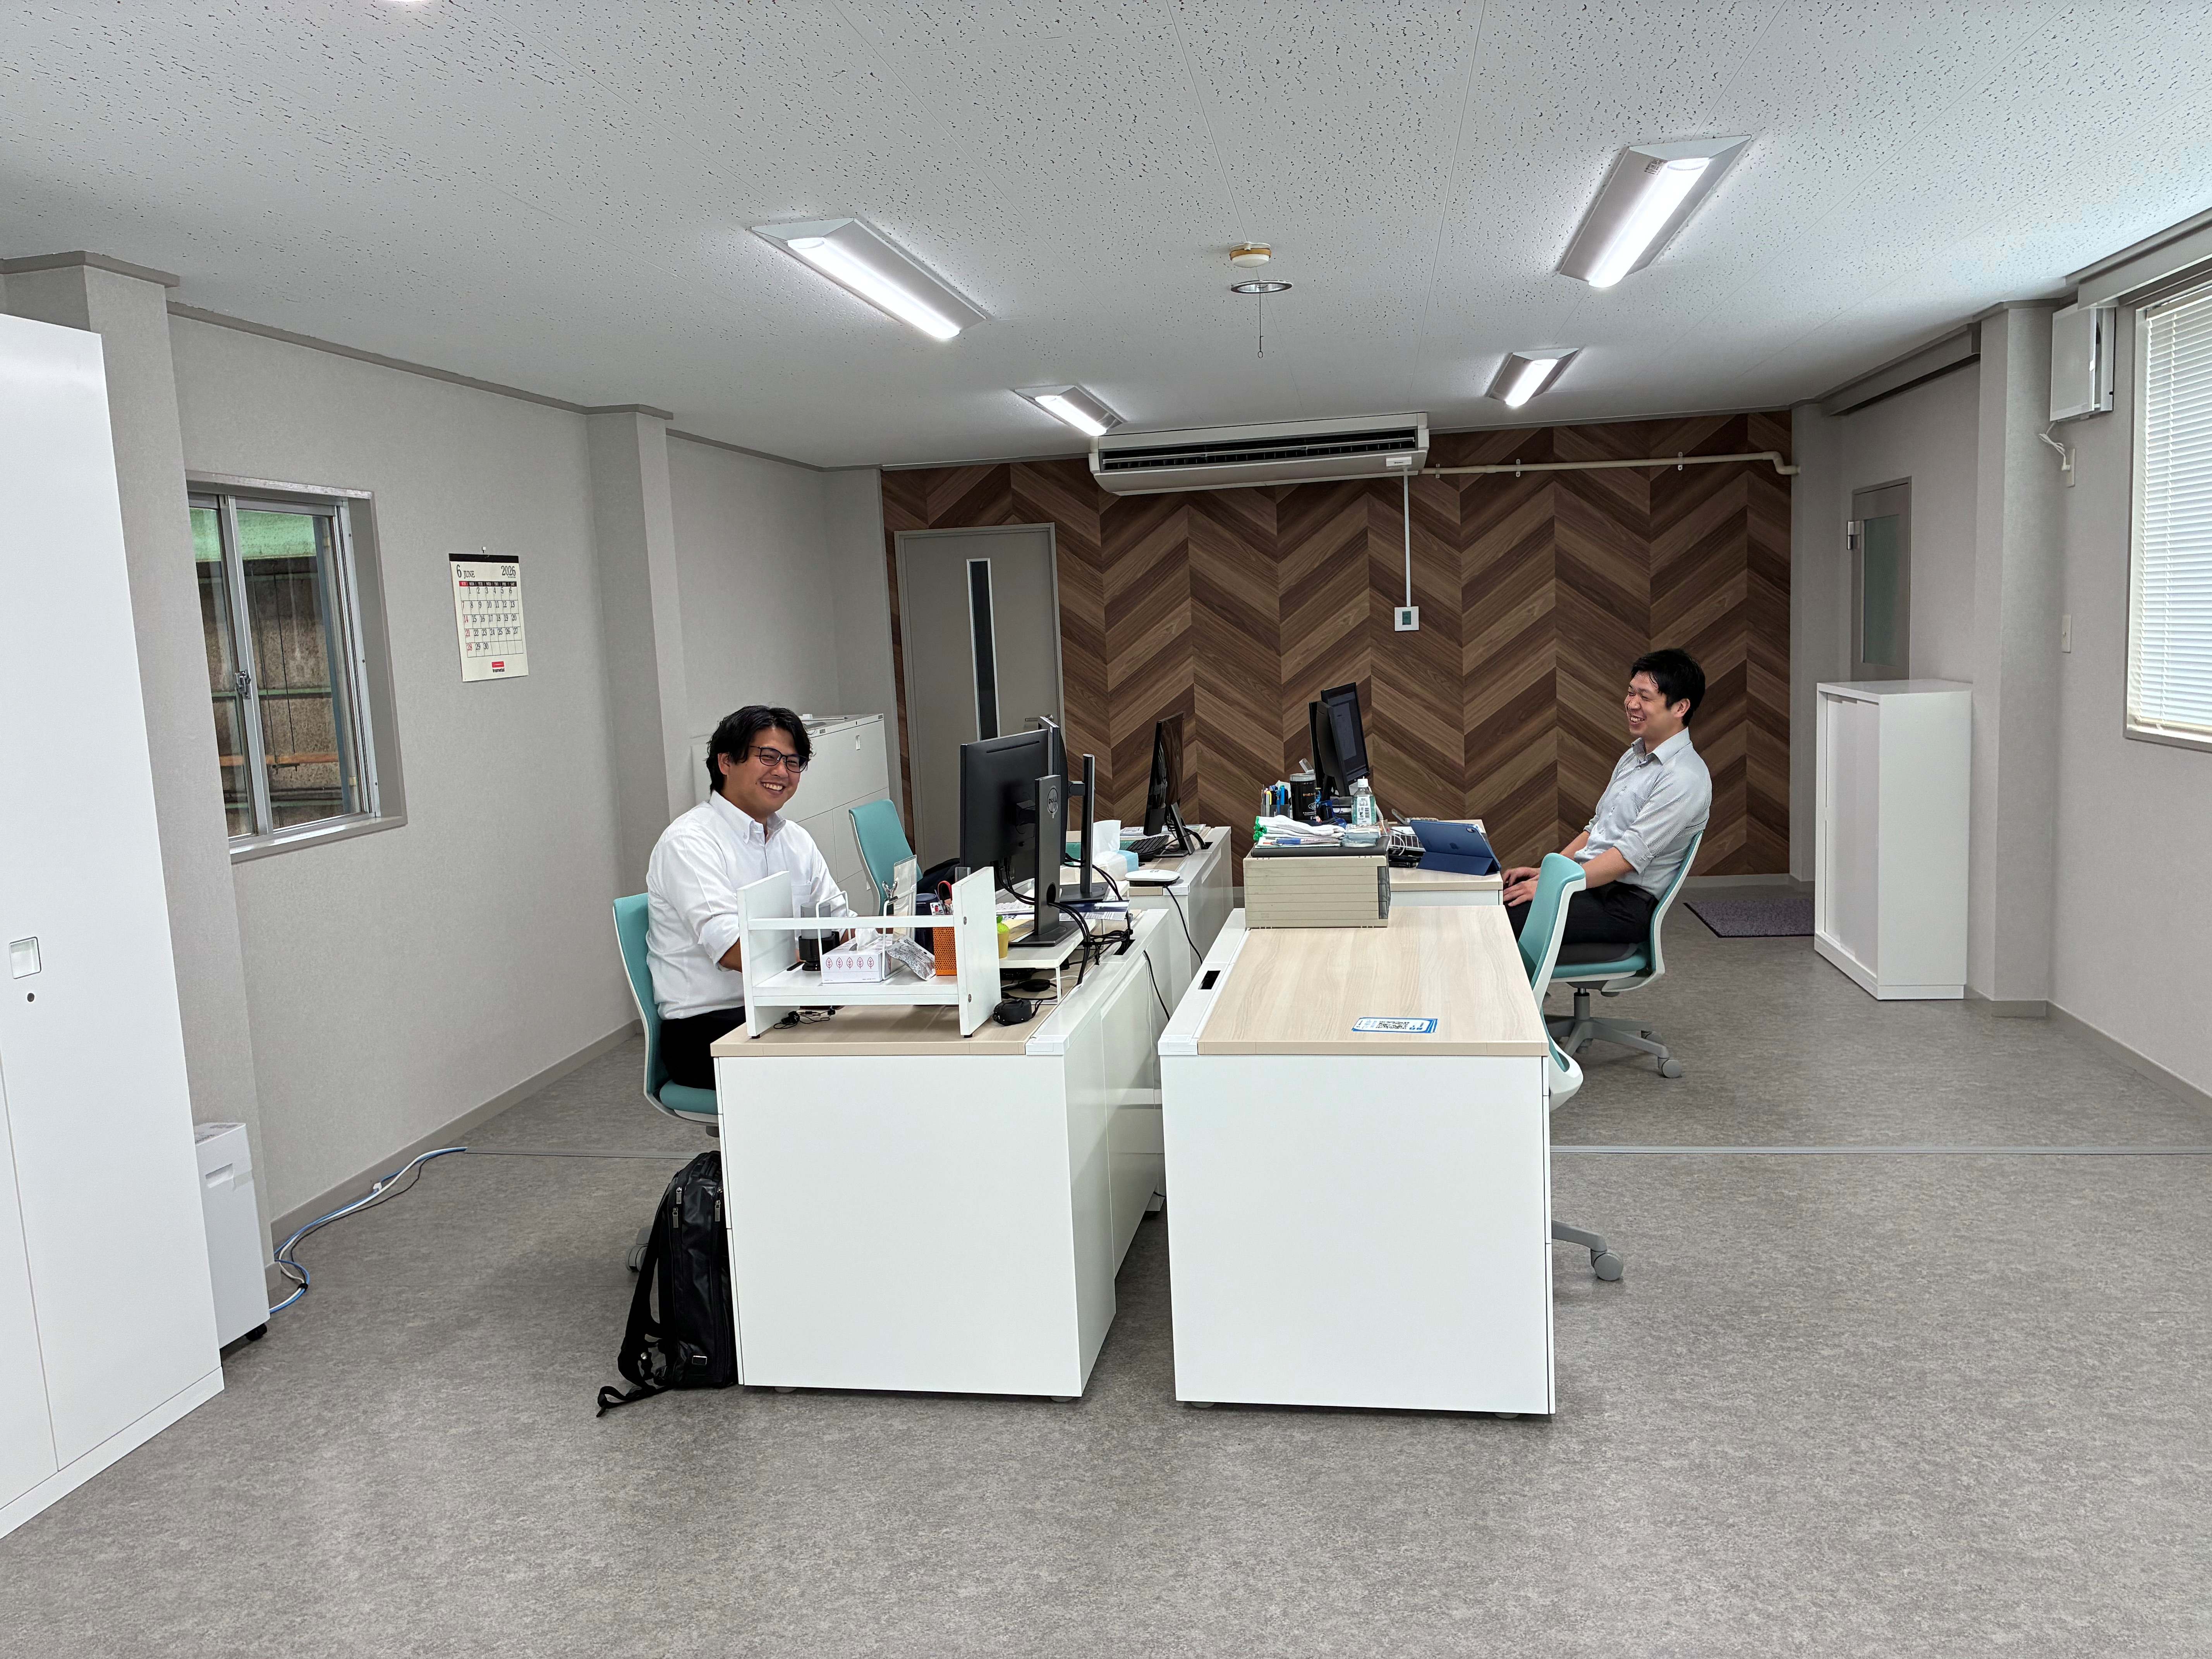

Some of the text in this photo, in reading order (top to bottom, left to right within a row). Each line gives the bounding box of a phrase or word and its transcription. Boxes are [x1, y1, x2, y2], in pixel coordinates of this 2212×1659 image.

[457, 564, 516, 579] 6 JUNE 2026
